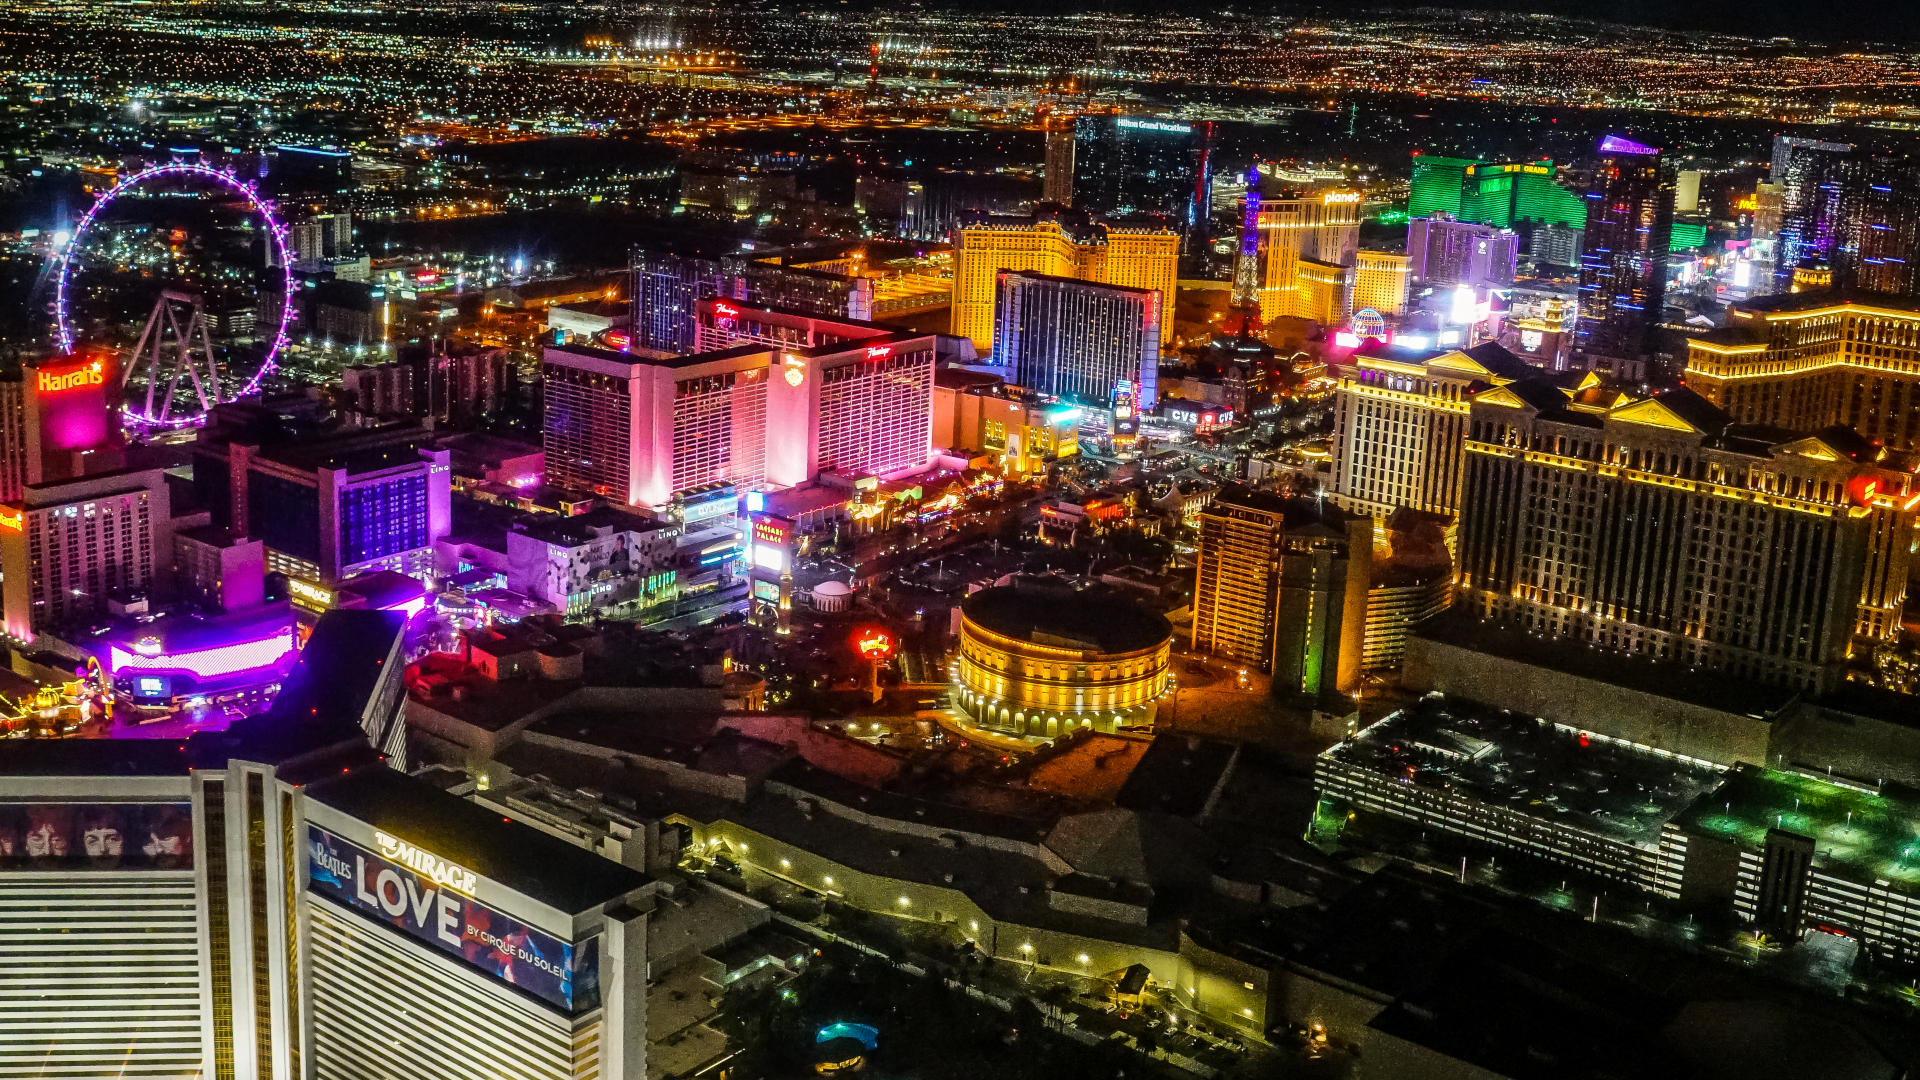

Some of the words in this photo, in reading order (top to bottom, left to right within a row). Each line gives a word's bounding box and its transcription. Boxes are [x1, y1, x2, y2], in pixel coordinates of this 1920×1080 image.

[1118, 119, 1138, 127] Hilton
[1139, 121, 1158, 129] Grand
[1159, 122, 1191, 132] Vacations
[1609, 145, 1659, 155] OSMOPOLITAN
[1523, 165, 1548, 174] GRAND
[1324, 191, 1360, 206] planet
[1172, 410, 1198, 423] CVS
[1219, 411, 1234, 423] CVS
[658, 529, 678, 539] LINQ
[755, 523, 783, 536] CAESARS
[756, 531, 782, 544] PALACE
[550, 548, 568, 558] LINQ
[591, 585, 611, 594] LINQ
[317, 843, 352, 879] BEATLES
[381, 842, 477, 895] MIRAGE
[356, 855, 461, 948] LOVE
[467, 924, 479, 937] BY
[480, 931, 516, 956] CIRQUE
[518, 949, 533, 963] DU
[534, 957, 568, 981] SOLEIL
